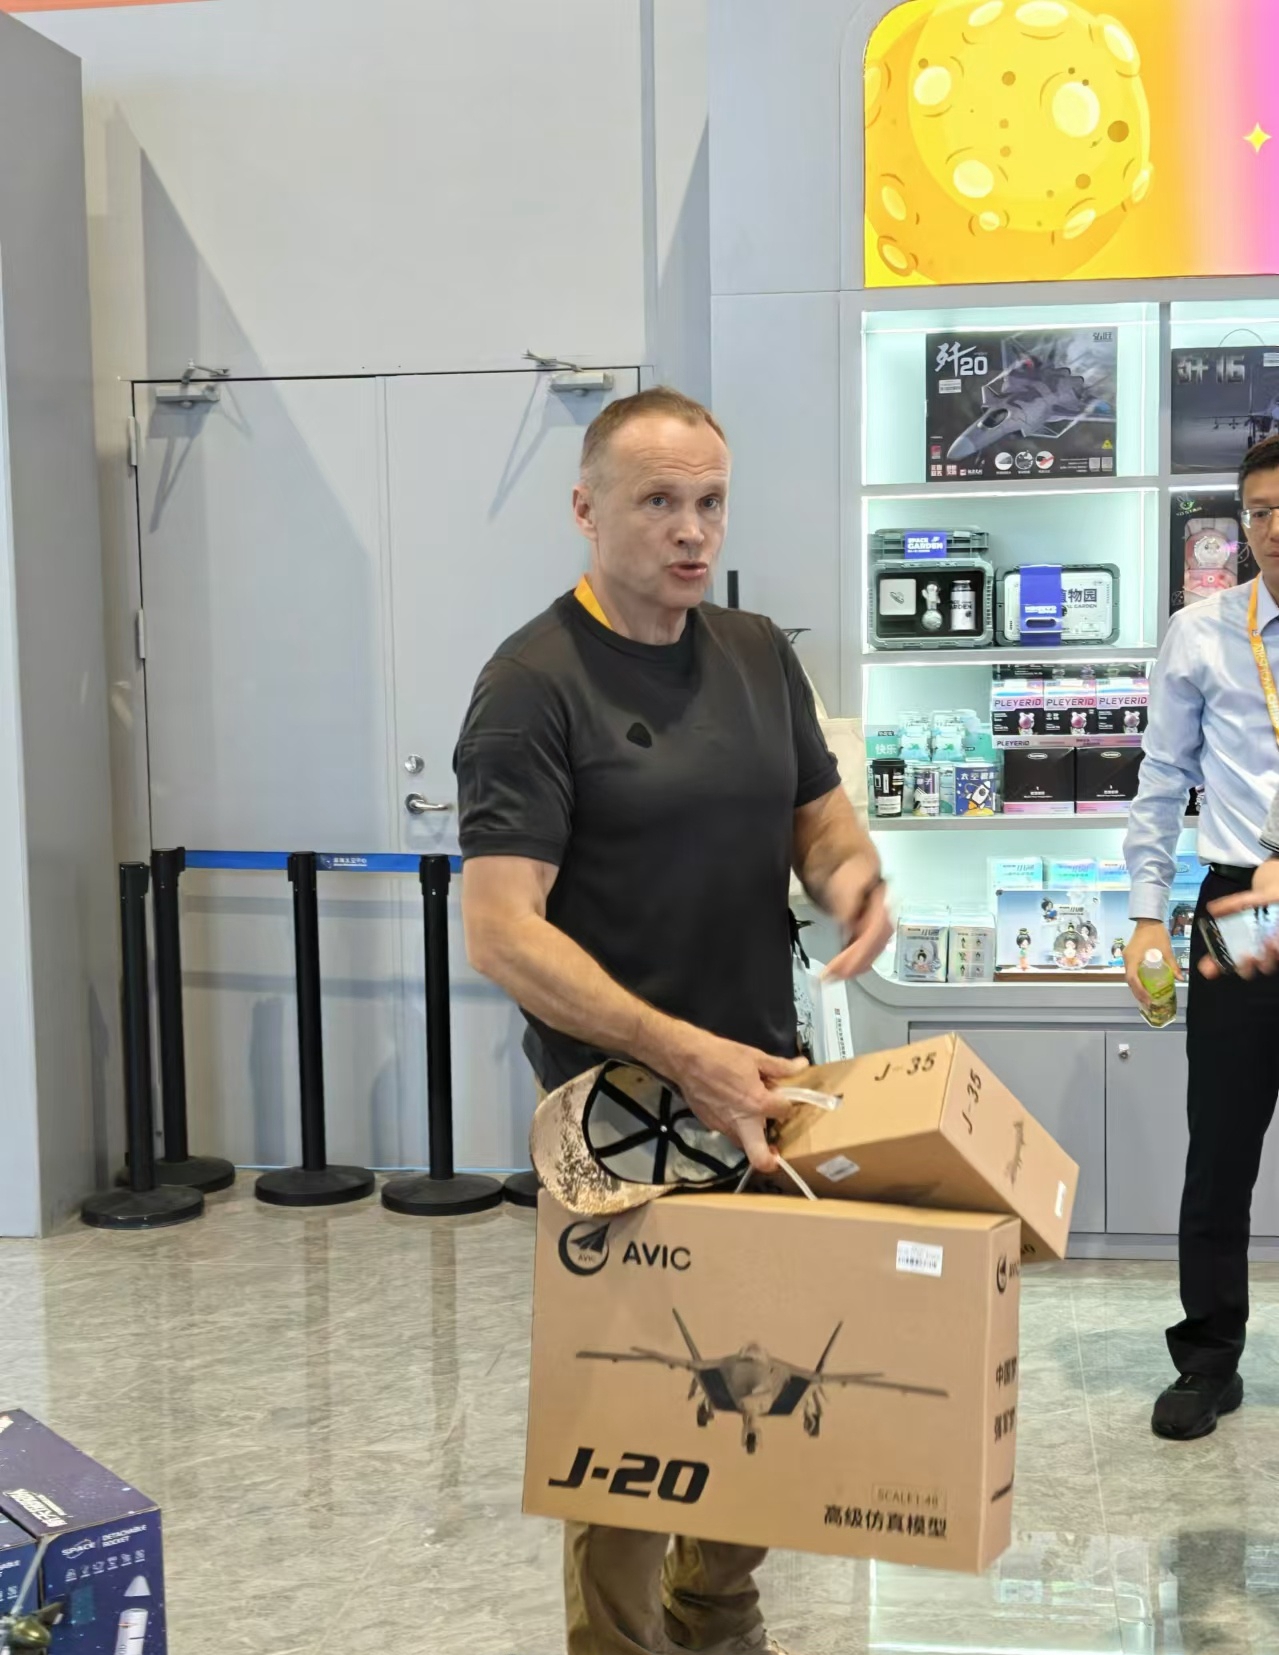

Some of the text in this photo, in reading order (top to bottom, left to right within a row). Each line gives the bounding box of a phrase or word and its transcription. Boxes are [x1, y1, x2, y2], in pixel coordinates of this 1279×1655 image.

[907, 542, 944, 550] GARDEN
[994, 698, 1042, 707] PLEYERID
[1046, 698, 1095, 706] PLEYERID
[1099, 696, 1148, 705] PLEYERID
[874, 1051, 937, 1082] J-35
[962, 1067, 982, 1135] J-35
[622, 1240, 691, 1271] AVIC
[548, 1446, 710, 1504] J-20
[61, 1541, 96, 1556] SPACE
